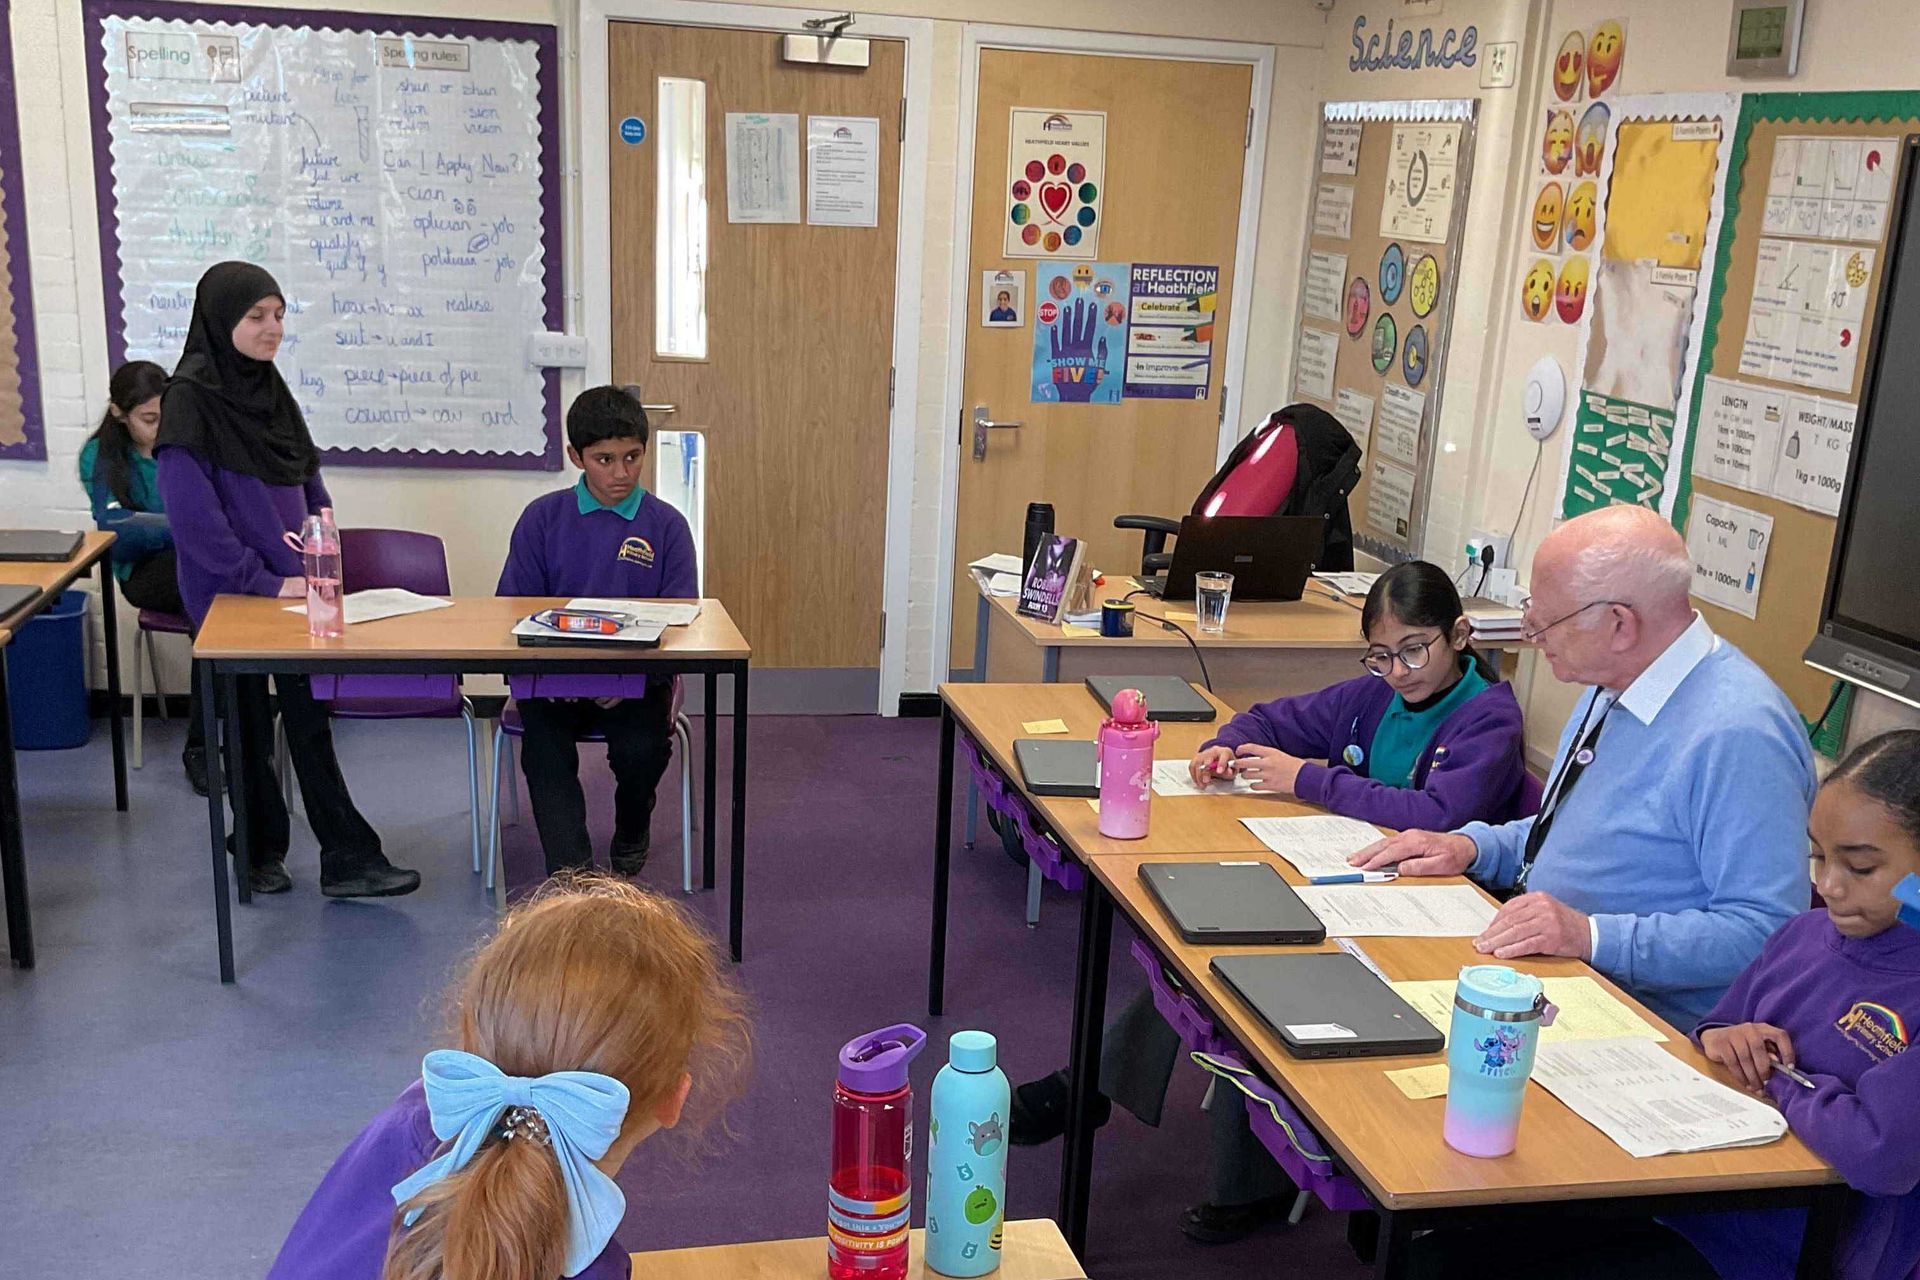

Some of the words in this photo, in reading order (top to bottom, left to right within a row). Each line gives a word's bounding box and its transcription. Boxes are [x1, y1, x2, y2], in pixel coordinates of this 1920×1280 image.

[1349, 15, 1478, 72] Science
[127, 45, 190, 64] Spelling
[384, 46, 429, 62] Speng
[397, 78, 431, 94] shun
[440, 84, 453, 94] or
[462, 81, 497, 96] zhun
[300, 146, 340, 175] future
[384, 150, 412, 169] Can
[436, 152, 473, 184] Apply
[481, 153, 518, 174] Now?
[332, 211, 355, 227] and
[360, 214, 376, 227] me
[413, 210, 472, 239] optician
[491, 215, 514, 245] job
[422, 246, 477, 276] politician
[495, 252, 516, 283] job
[1133, 268, 1216, 283] REFLECTION
[1132, 282, 1146, 293] at
[1148, 282, 1216, 295] Heathfield
[332, 292, 367, 315] hoax
[446, 292, 495, 313] realise
[1141, 302, 1181, 312] Celebrate
[1039, 308, 1058, 317] STOP
[336, 321, 369, 346] suit
[387, 336, 398, 348] u
[401, 331, 425, 347] and
[426, 332, 435, 347] I
[1052, 357, 1086, 367] SHOW
[1088, 358, 1105, 368] ME
[344, 368, 388, 395] piece
[399, 371, 436, 395] piece
[440, 361, 454, 396] of
[460, 370, 482, 394] pie
[1722, 395, 1748, 410] LENGTH
[345, 400, 412, 425] coward
[432, 409, 463, 424] cow
[482, 400, 518, 426] ard
[1798, 411, 1853, 433] WEIGHT/MASS
[1718, 424, 1729, 435] 1km
[1736, 428, 1755, 441] 1000m
[1716, 440, 1725, 449] 1m
[1732, 443, 1752, 456] 100cm
[1826, 438, 1840, 450] KG
[1714, 454, 1726, 464] 1cm
[1732, 459, 1750, 472] 10mm
[1795, 468, 1808, 484] 1kg
[1818, 474, 1842, 494] 1000g
[1706, 512, 1738, 534] Capacity
[1714, 570, 1741, 588] 1000ml
[1022, 588, 1061, 606] SWINDELLS
[1042, 604, 1048, 614] 13
[1860, 1011, 1909, 1054] Heathfield
